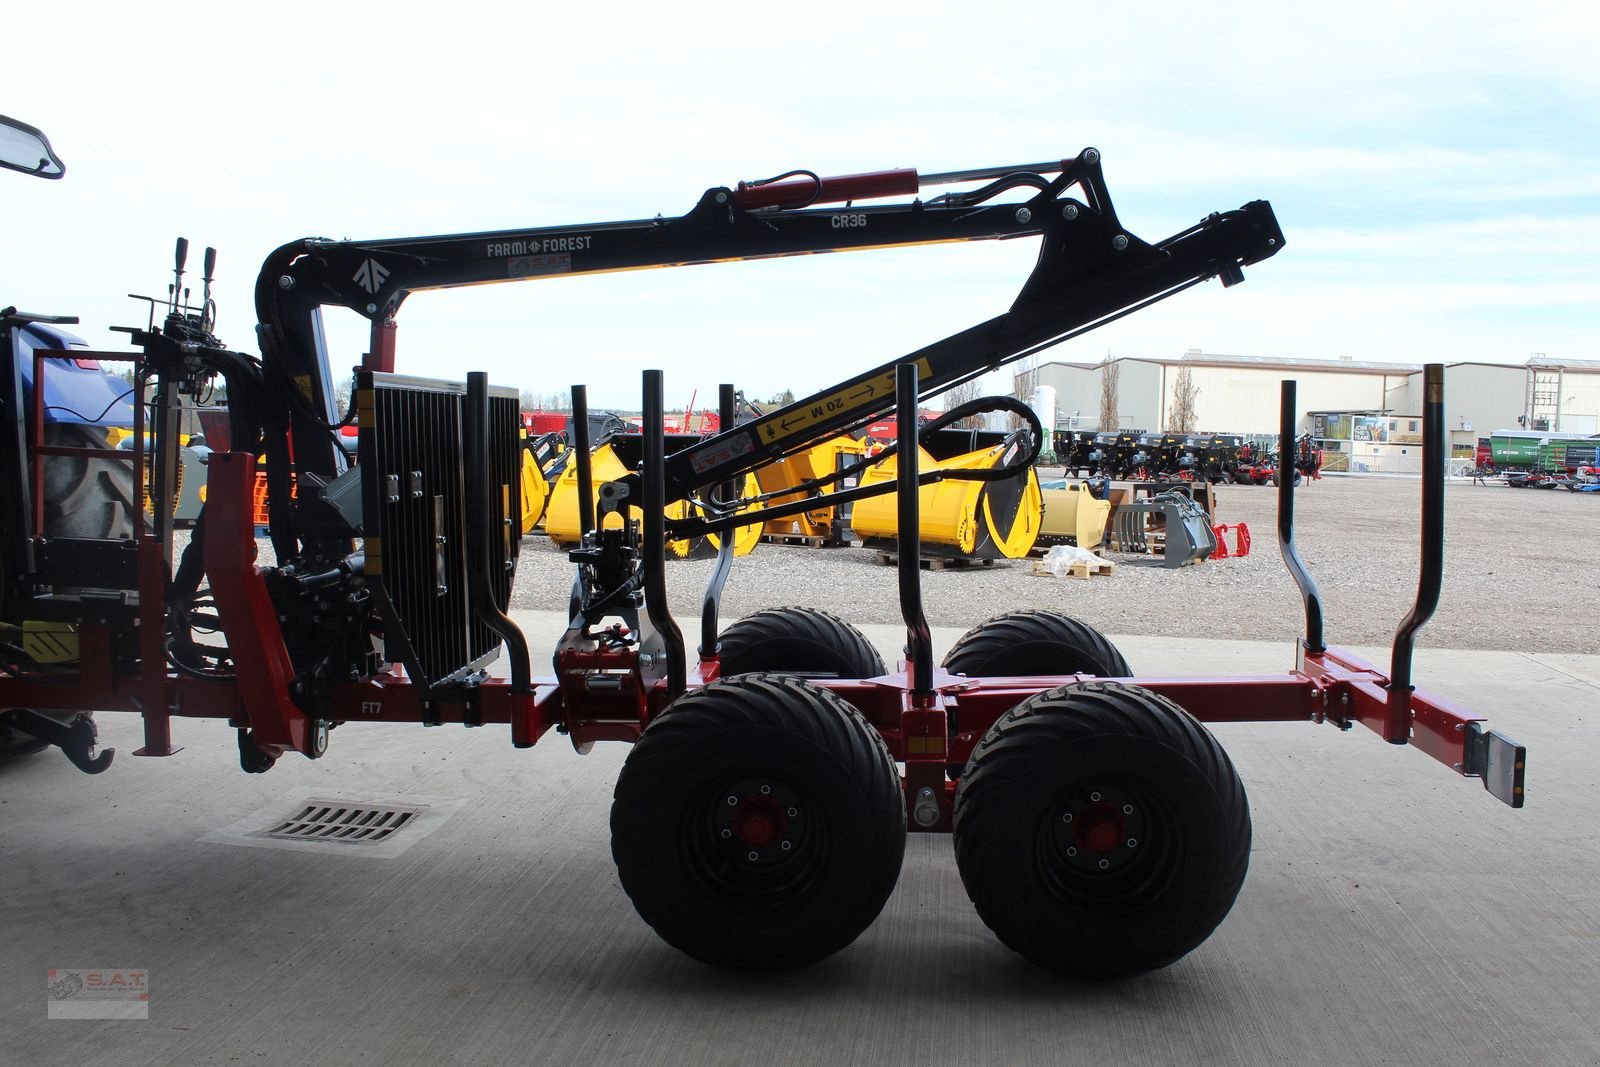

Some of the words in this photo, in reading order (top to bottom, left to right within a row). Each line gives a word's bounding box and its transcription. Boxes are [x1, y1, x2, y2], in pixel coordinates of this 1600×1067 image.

[831, 214, 867, 228] CR36
[487, 241, 527, 257] FARMI
[543, 236, 592, 252] FOREST
[826, 398, 844, 411] 20
[810, 406, 824, 418] M
[362, 701, 382, 714] FT7
